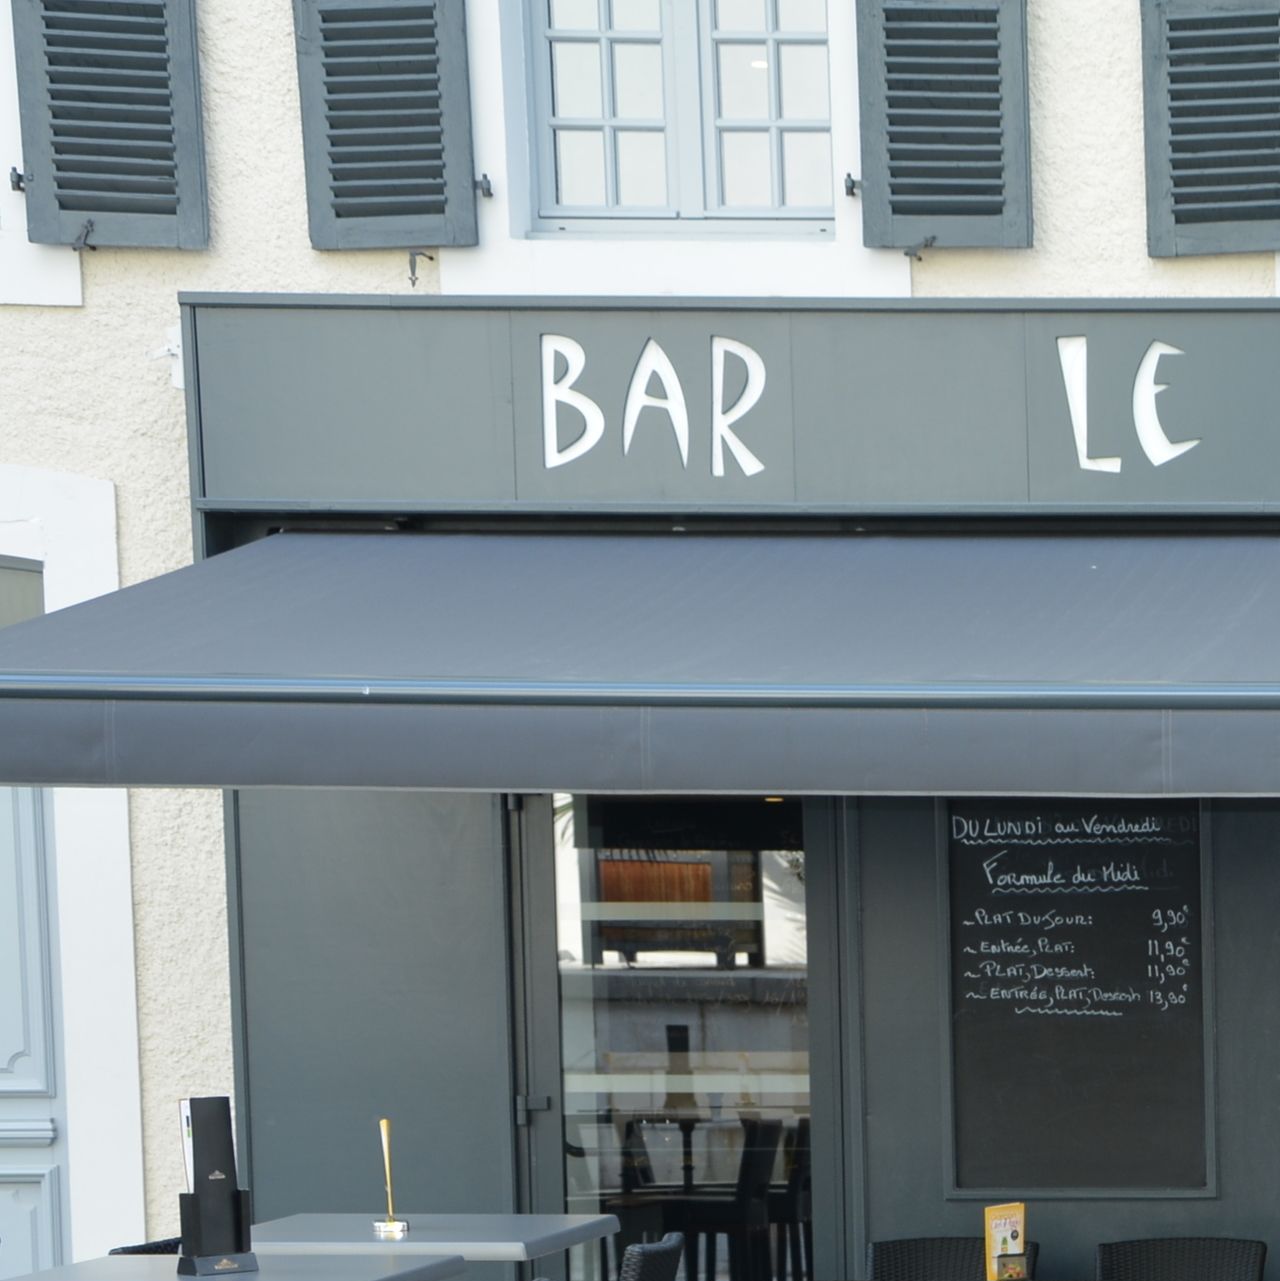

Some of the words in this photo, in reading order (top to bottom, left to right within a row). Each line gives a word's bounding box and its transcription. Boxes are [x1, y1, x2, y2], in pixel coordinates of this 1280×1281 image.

[541, 334, 767, 477] BAR
[1056, 336, 1200, 474] LE
[952, 815, 979, 840] DU
[1055, 822, 1079, 833] au
[1082, 814, 1161, 835] Vendredi
[1072, 865, 1095, 883] du
[1102, 862, 1141, 882] Midi
